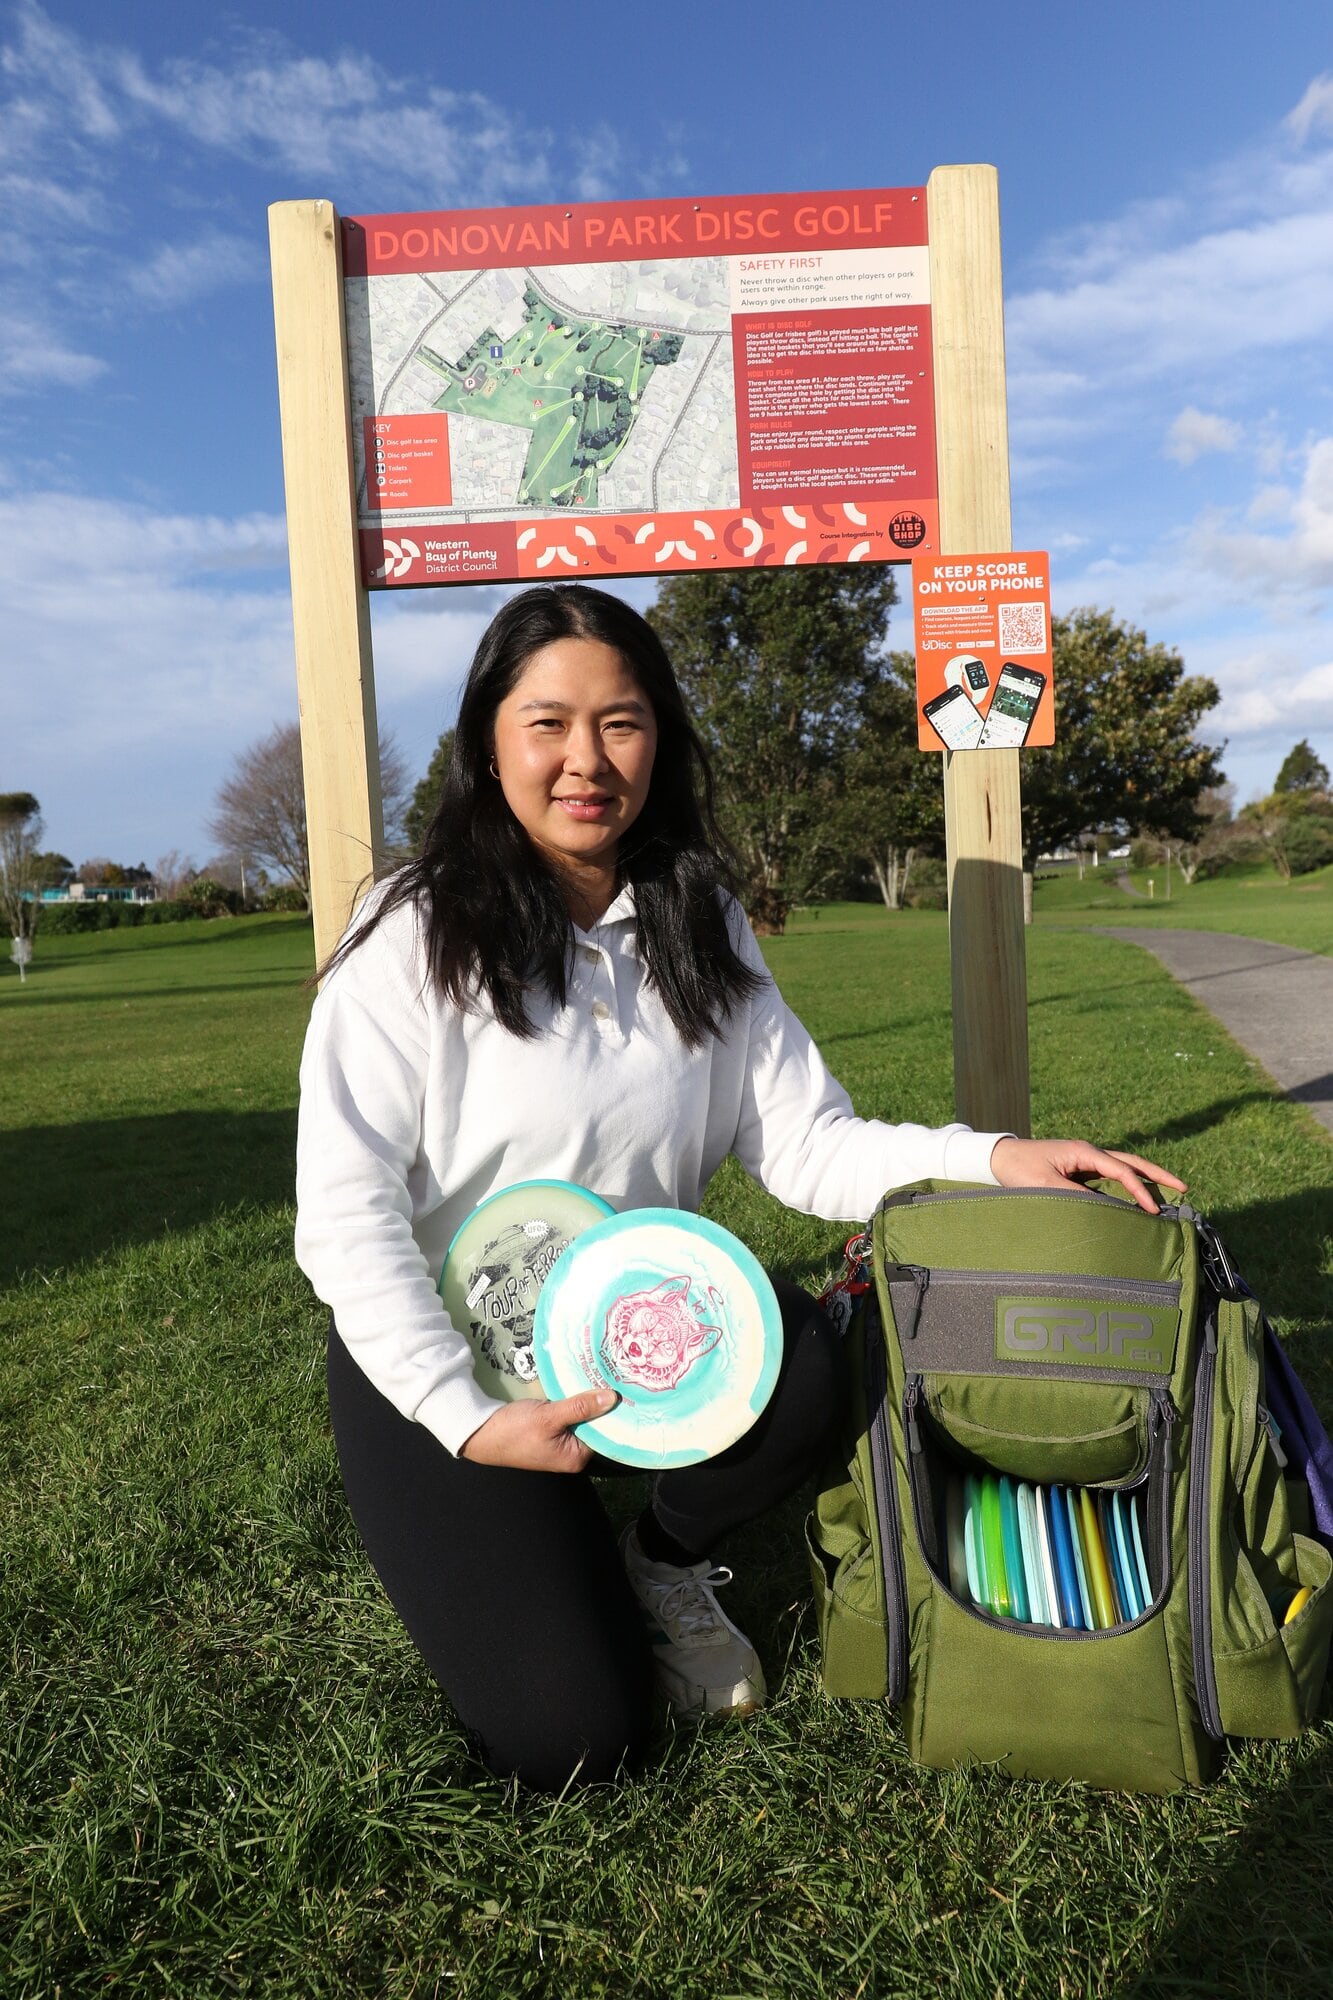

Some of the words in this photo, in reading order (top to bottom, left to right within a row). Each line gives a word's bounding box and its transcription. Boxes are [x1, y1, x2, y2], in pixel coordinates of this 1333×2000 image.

[373, 220, 570, 260] DONOVAN
[584, 214, 684, 248] PARK
[695, 208, 781, 241] DISC
[793, 203, 893, 237] GOLF
[739, 259, 785, 271] SAFETY
[789, 257, 824, 269] FIRST
[857, 272, 885, 282] players
[897, 271, 915, 280] park
[776, 284, 800, 292] within
[801, 284, 826, 292] range.
[740, 298, 768, 307] Always
[769, 297, 785, 306] give
[787, 296, 808, 304] other
[809, 296, 827, 304] park
[865, 293, 882, 302] right
[372, 423, 391, 433] KEY
[750, 431, 770, 439] Please
[771, 430, 788, 439] enjoy
[804, 429, 824, 437] round,
[825, 427, 848, 436] respect
[866, 426, 888, 434] people
[888, 425, 905, 433] using
[400, 438, 412, 447] golf
[750, 437, 764, 446] park
[809, 434, 835, 443] damage
[843, 433, 863, 442] plants
[876, 431, 894, 439] trees.
[895, 430, 916, 438] Please
[750, 444, 763, 452] pick
[763, 444, 772, 452] up
[773, 442, 796, 450] rubbish
[400, 451, 413, 459] golf
[789, 468, 811, 476] normal
[812, 467, 837, 475] frisbees
[861, 464, 905, 472] recommended
[752, 476, 775, 485] players
[806, 474, 819, 483] golf
[819, 473, 843, 482] specific
[859, 471, 877, 479] These
[760, 482, 782, 491] bought
[783, 481, 799, 489] from
[826, 479, 846, 488] sports
[847, 478, 866, 486] stores
[893, 522, 922, 532] DISC
[841, 531, 875, 540] Integration
[875, 530, 884, 538] by
[893, 531, 922, 540] SHOP
[424, 540, 470, 551] Western
[425, 552, 447, 564] Bay
[448, 550, 461, 560] of
[462, 549, 498, 561] Plenty
[426, 563, 461, 574] District
[462, 561, 498, 572] Council
[934, 565, 973, 579] KEEP
[976, 562, 1028, 577] SCORE
[918, 581, 942, 595] ON
[945, 579, 987, 593] YOUR
[990, 576, 1044, 591] PHONE
[923, 607, 961, 615] DOWNLOAD
[922, 639, 953, 650] UDisc
[477, 1276, 526, 1324] TOUR
[519, 1275, 533, 1295] OF
[1005, 1306, 1153, 1356] GRIP
[1129, 1347, 1163, 1365] EQ
